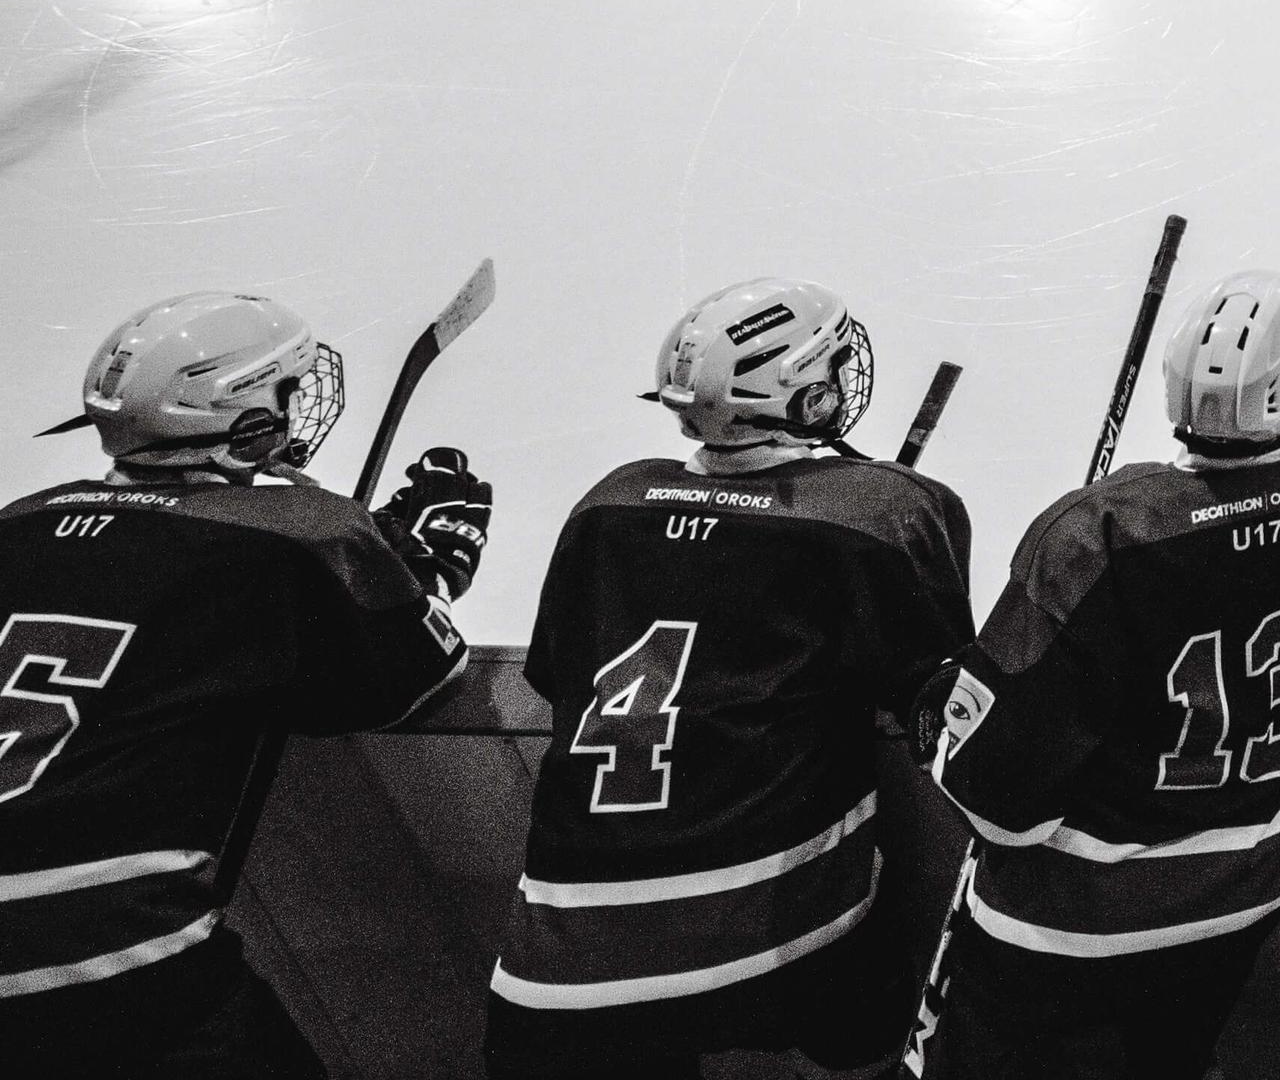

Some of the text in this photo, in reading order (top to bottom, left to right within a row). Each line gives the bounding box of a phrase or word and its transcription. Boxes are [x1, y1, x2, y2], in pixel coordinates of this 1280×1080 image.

[1116, 363, 1136, 418] SUPER
[117, 492, 180, 507] OROKS
[644, 487, 773, 509] DECATHLON OROKS
[1190, 495, 1263, 524] DECATHLON
[54, 514, 115, 538] U17
[666, 514, 719, 541] U17
[569, 619, 699, 814] 4
